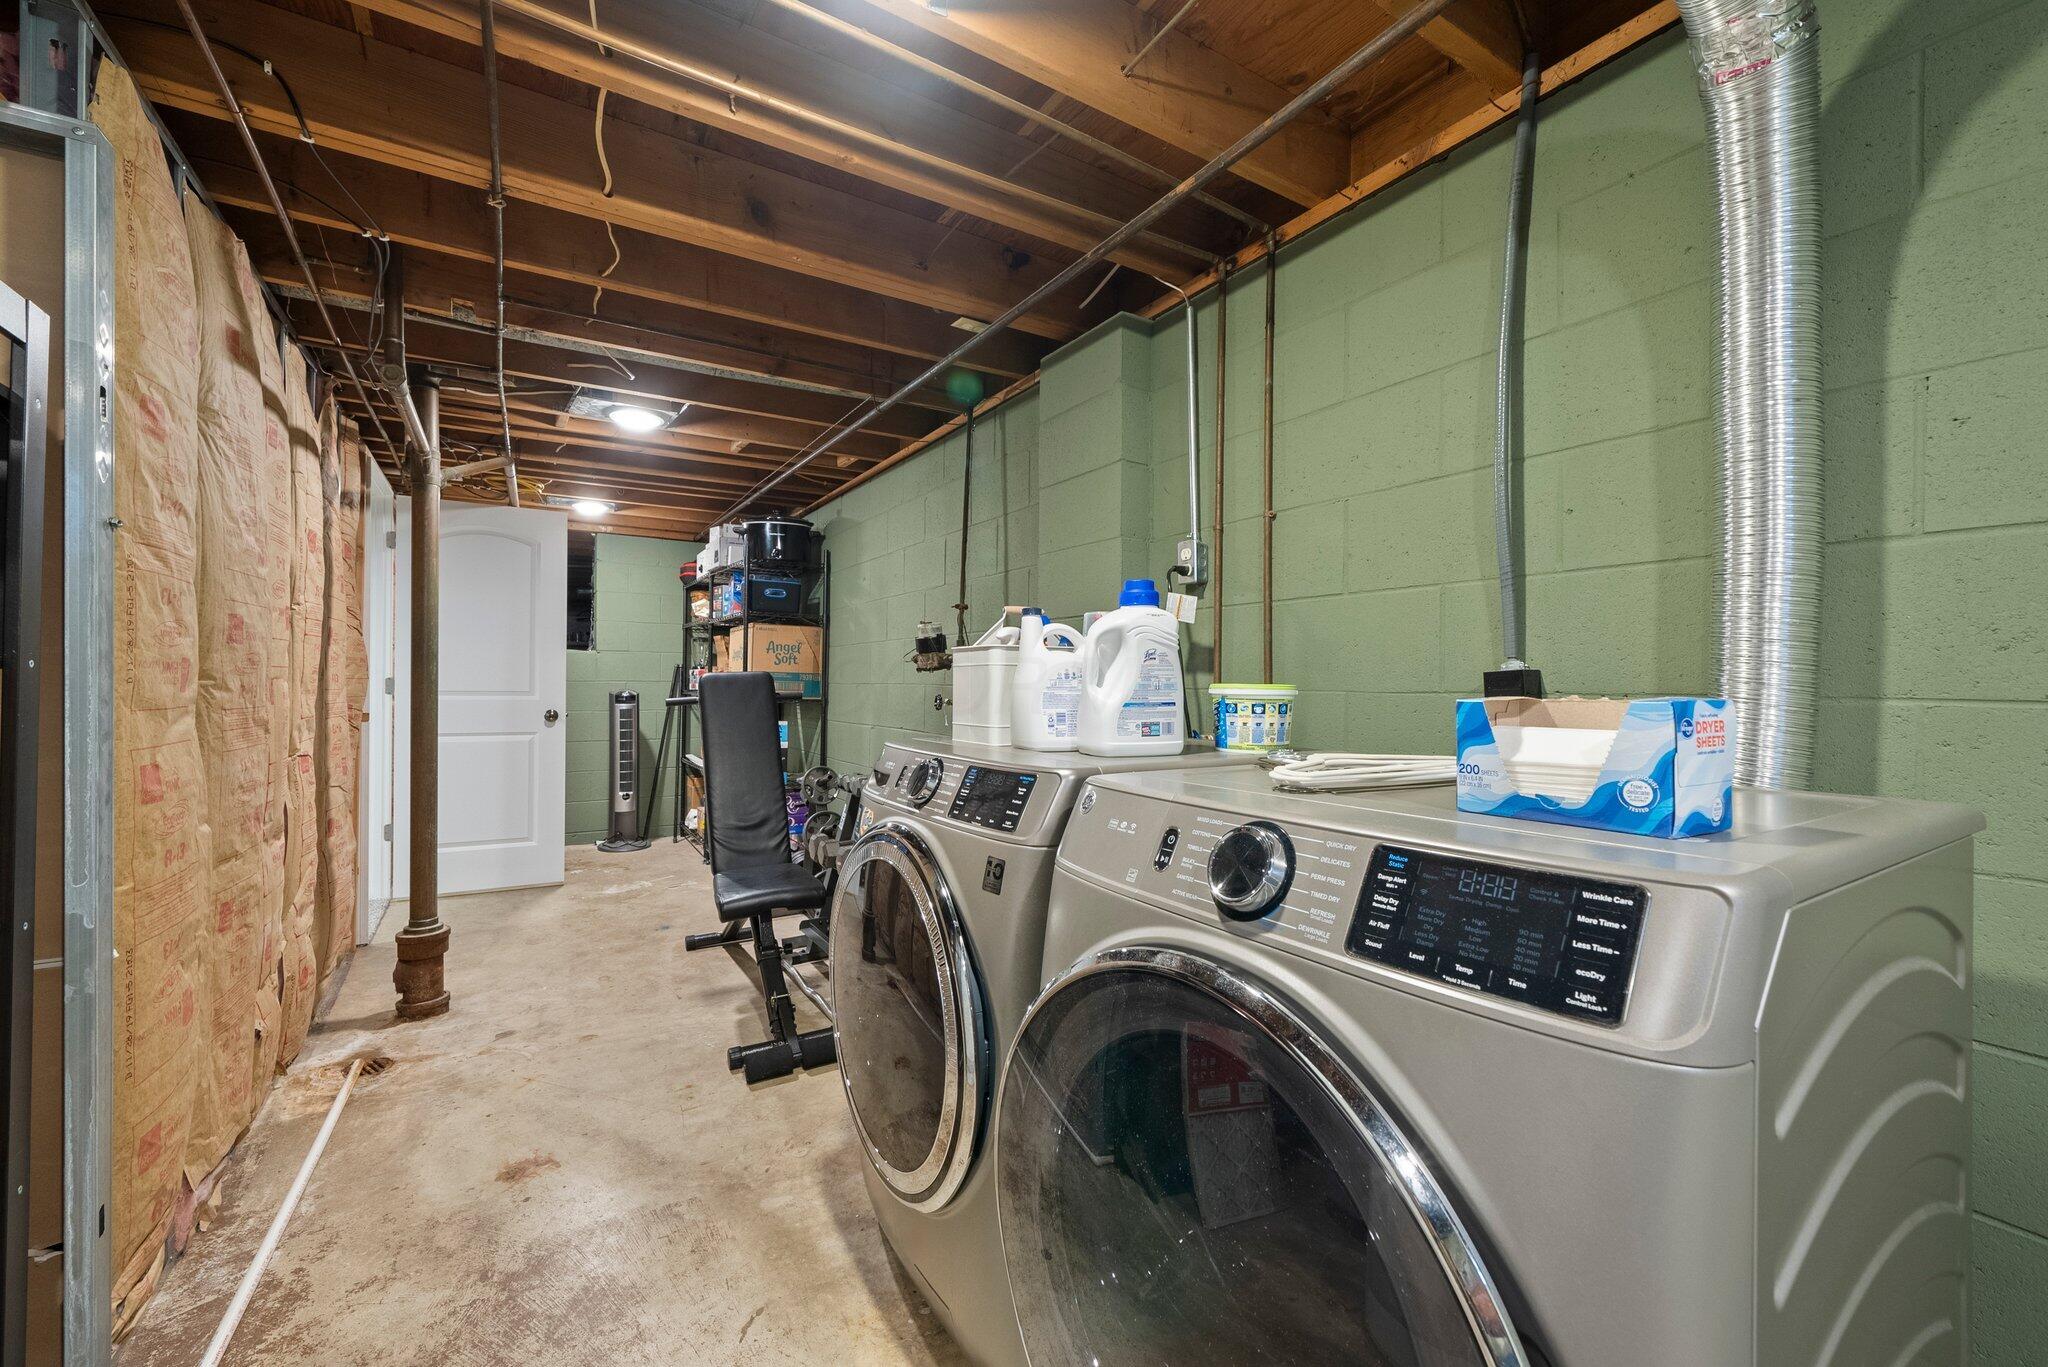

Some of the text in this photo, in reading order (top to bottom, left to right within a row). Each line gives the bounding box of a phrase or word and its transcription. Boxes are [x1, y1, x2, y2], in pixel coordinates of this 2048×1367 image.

[766, 640, 802, 655] Angel
[774, 652, 798, 666] Soft
[1695, 720, 1726, 734] DRYER
[1696, 735, 1726, 748] SHEETS
[1458, 763, 1480, 775] 200
[1326, 841, 1357, 852] QUICK DRY
[1320, 856, 1351, 868] DELICATES
[1388, 853, 1409, 862] Reduce
[1388, 860, 1405, 869] Static
[1310, 873, 1346, 887] PERM PRESS
[1377, 873, 1407, 885] Damp Alert
[1310, 890, 1341, 903] TIMED DRY
[1373, 894, 1400, 906] Delay Dry
[1582, 891, 1634, 906] Wrinkle Care
[1310, 908, 1336, 920] REFRESH
[1419, 906, 1447, 918] Extra Dry
[1377, 921, 1391, 930] Fluff
[1417, 914, 1444, 926] More Dry
[1472, 917, 1487, 927] High
[1576, 914, 1598, 926] More
[1599, 918, 1620, 929] Time
[1298, 924, 1331, 939] DEWRINKLE
[1423, 923, 1434, 932] Dry
[1465, 925, 1491, 936] Medium
[1519, 928, 1544, 939] 90 min
[1414, 930, 1439, 942] Less Dry
[1469, 935, 1482, 943] Low
[1365, 939, 1383, 949] Sound
[1416, 938, 1434, 948] Damp
[1458, 941, 1489, 953] Extra Low
[1517, 937, 1542, 949] 60 min
[1572, 939, 1592, 950] Less
[1592, 944, 1613, 955] Time
[1409, 952, 1425, 962] Level
[1459, 950, 1485, 961] No Heat
[1526, 949, 1541, 958] min
[1513, 954, 1539, 966] 20 min
[1455, 963, 1474, 976] Temp
[1512, 963, 1536, 975] 10 min
[1575, 968, 1606, 982] ecoDry
[1508, 977, 1528, 989] Time
[1574, 991, 1597, 1004] Light
[1565, 997, 1602, 1012] Control Lock
